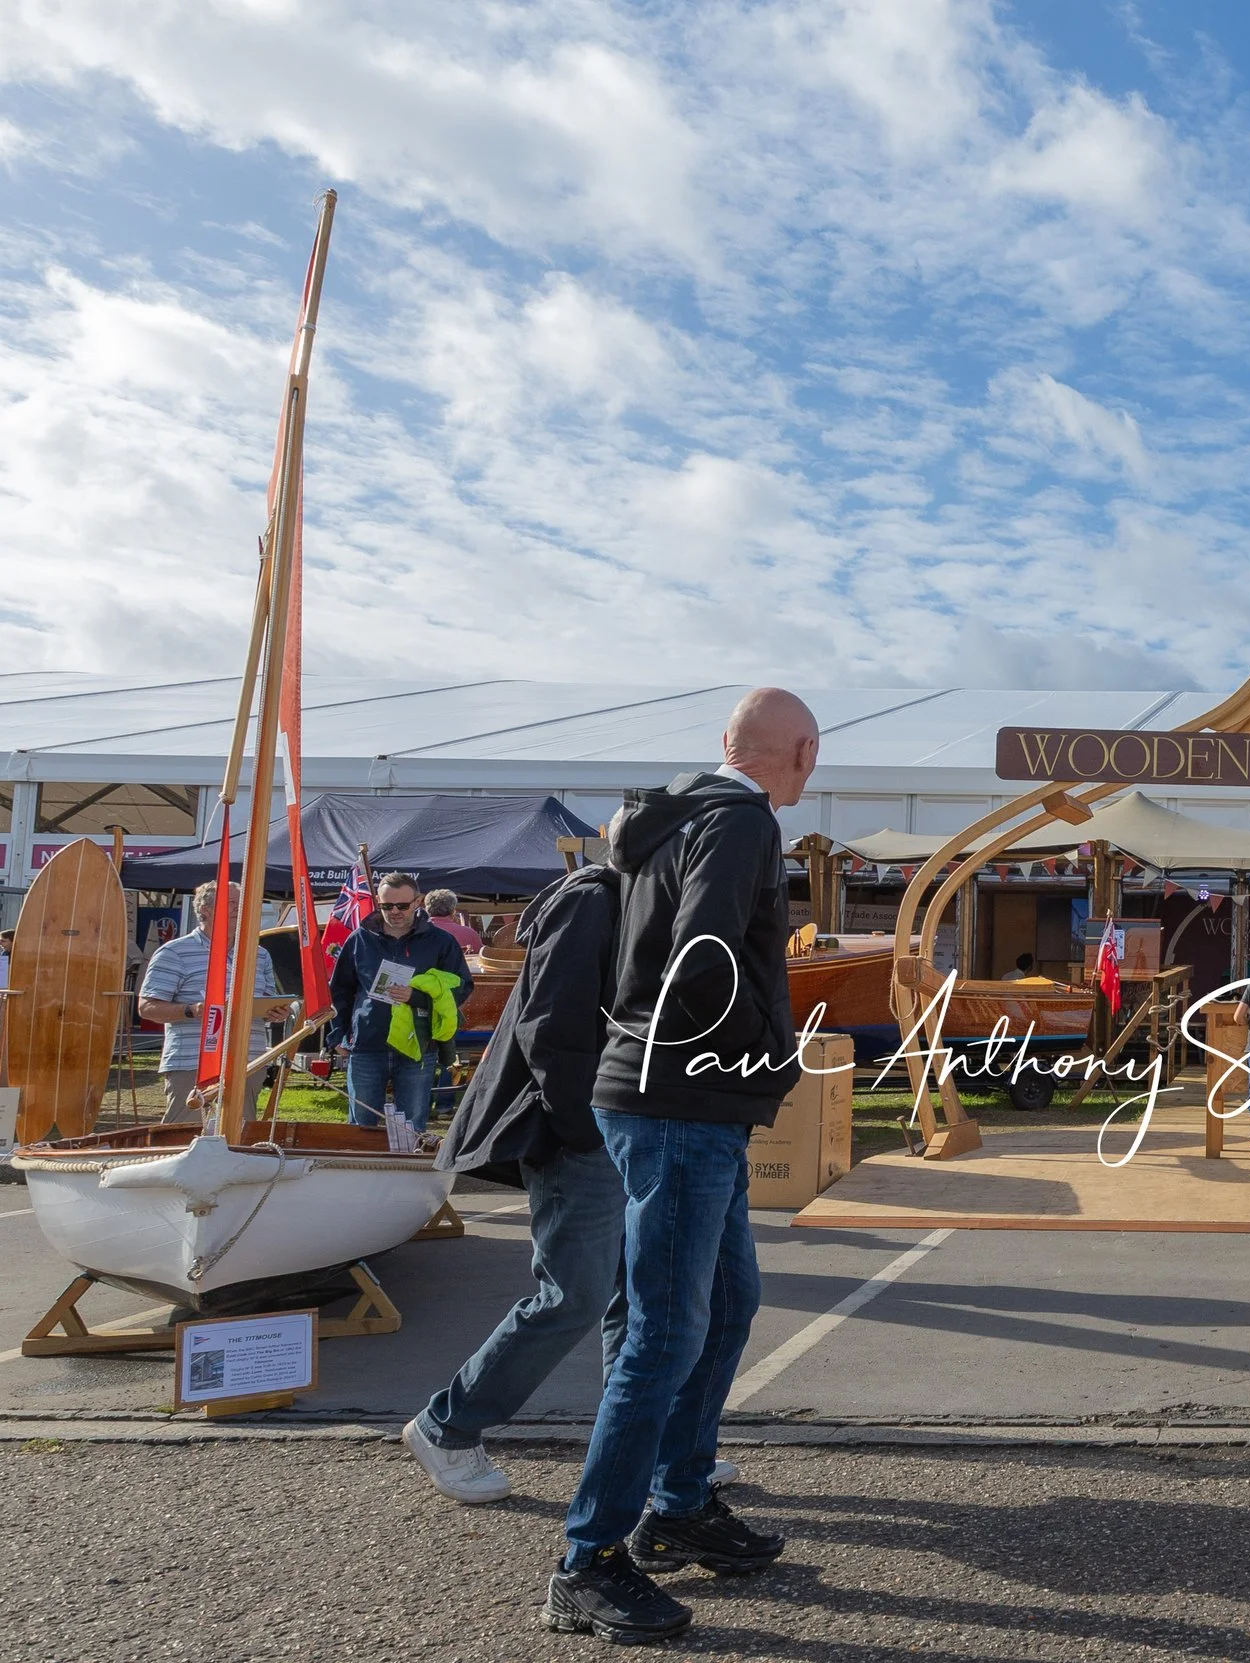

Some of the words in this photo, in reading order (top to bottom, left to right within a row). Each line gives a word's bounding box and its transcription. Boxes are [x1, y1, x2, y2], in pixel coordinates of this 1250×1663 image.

[1016, 732, 1250, 781] WOODEN
[872, 911, 922, 920] Assocn
[755, 1162, 790, 1172] SYKES
[755, 1171, 790, 1179] TIMBER
[228, 1336, 243, 1344] THE
[245, 1332, 282, 1342] TITMOUSE
